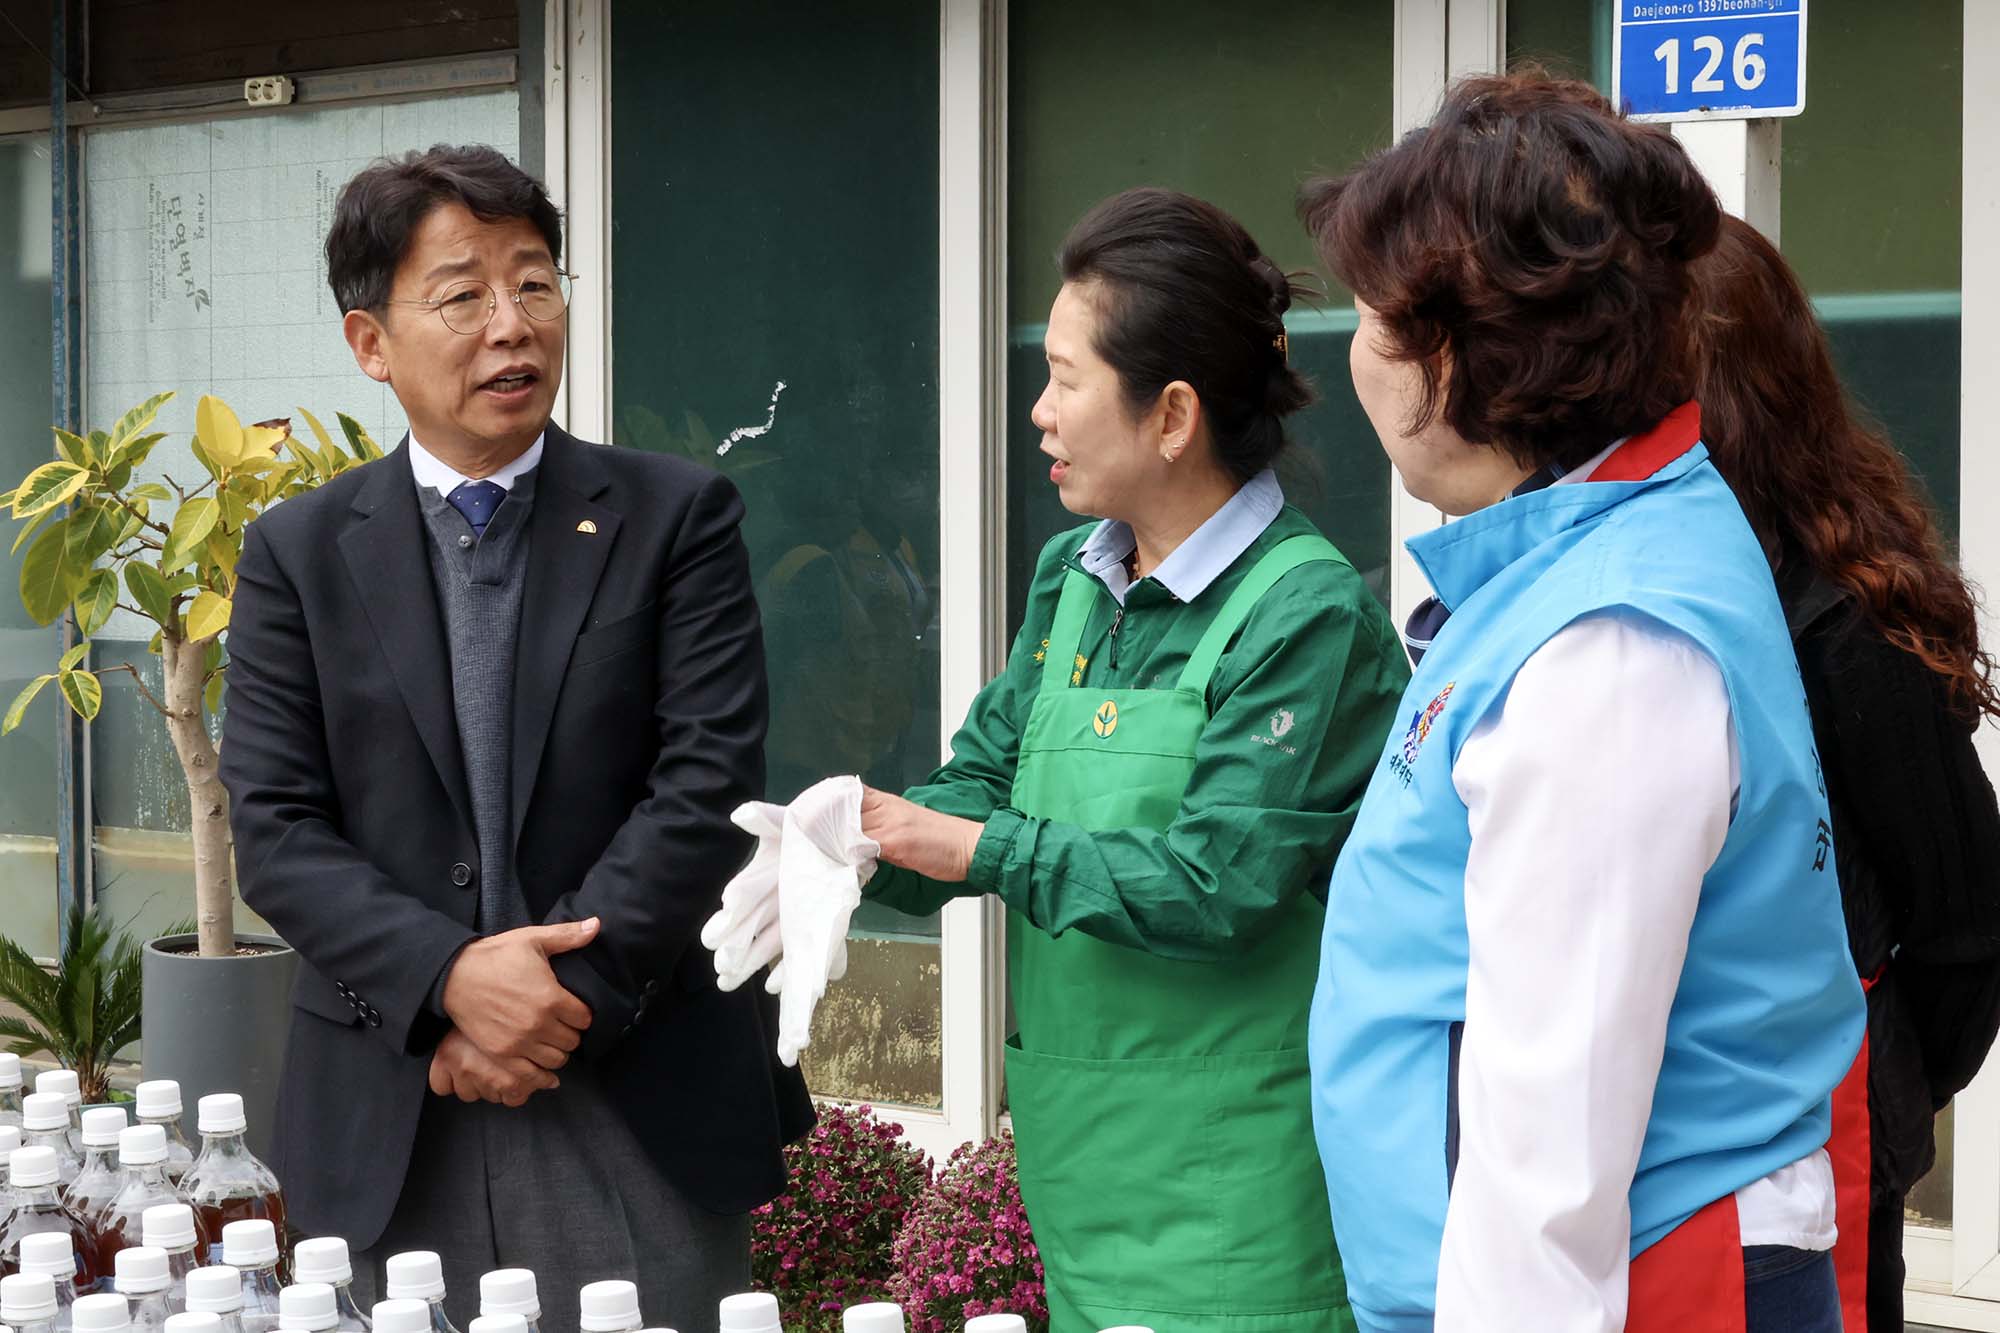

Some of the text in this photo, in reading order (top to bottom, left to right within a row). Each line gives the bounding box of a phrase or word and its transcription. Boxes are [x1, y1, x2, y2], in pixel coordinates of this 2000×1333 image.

[1633, 3, 1694, 19] Daejeon-ro
[1654, 32, 1767, 94] 126
[167, 196, 196, 299] 단열벽지
